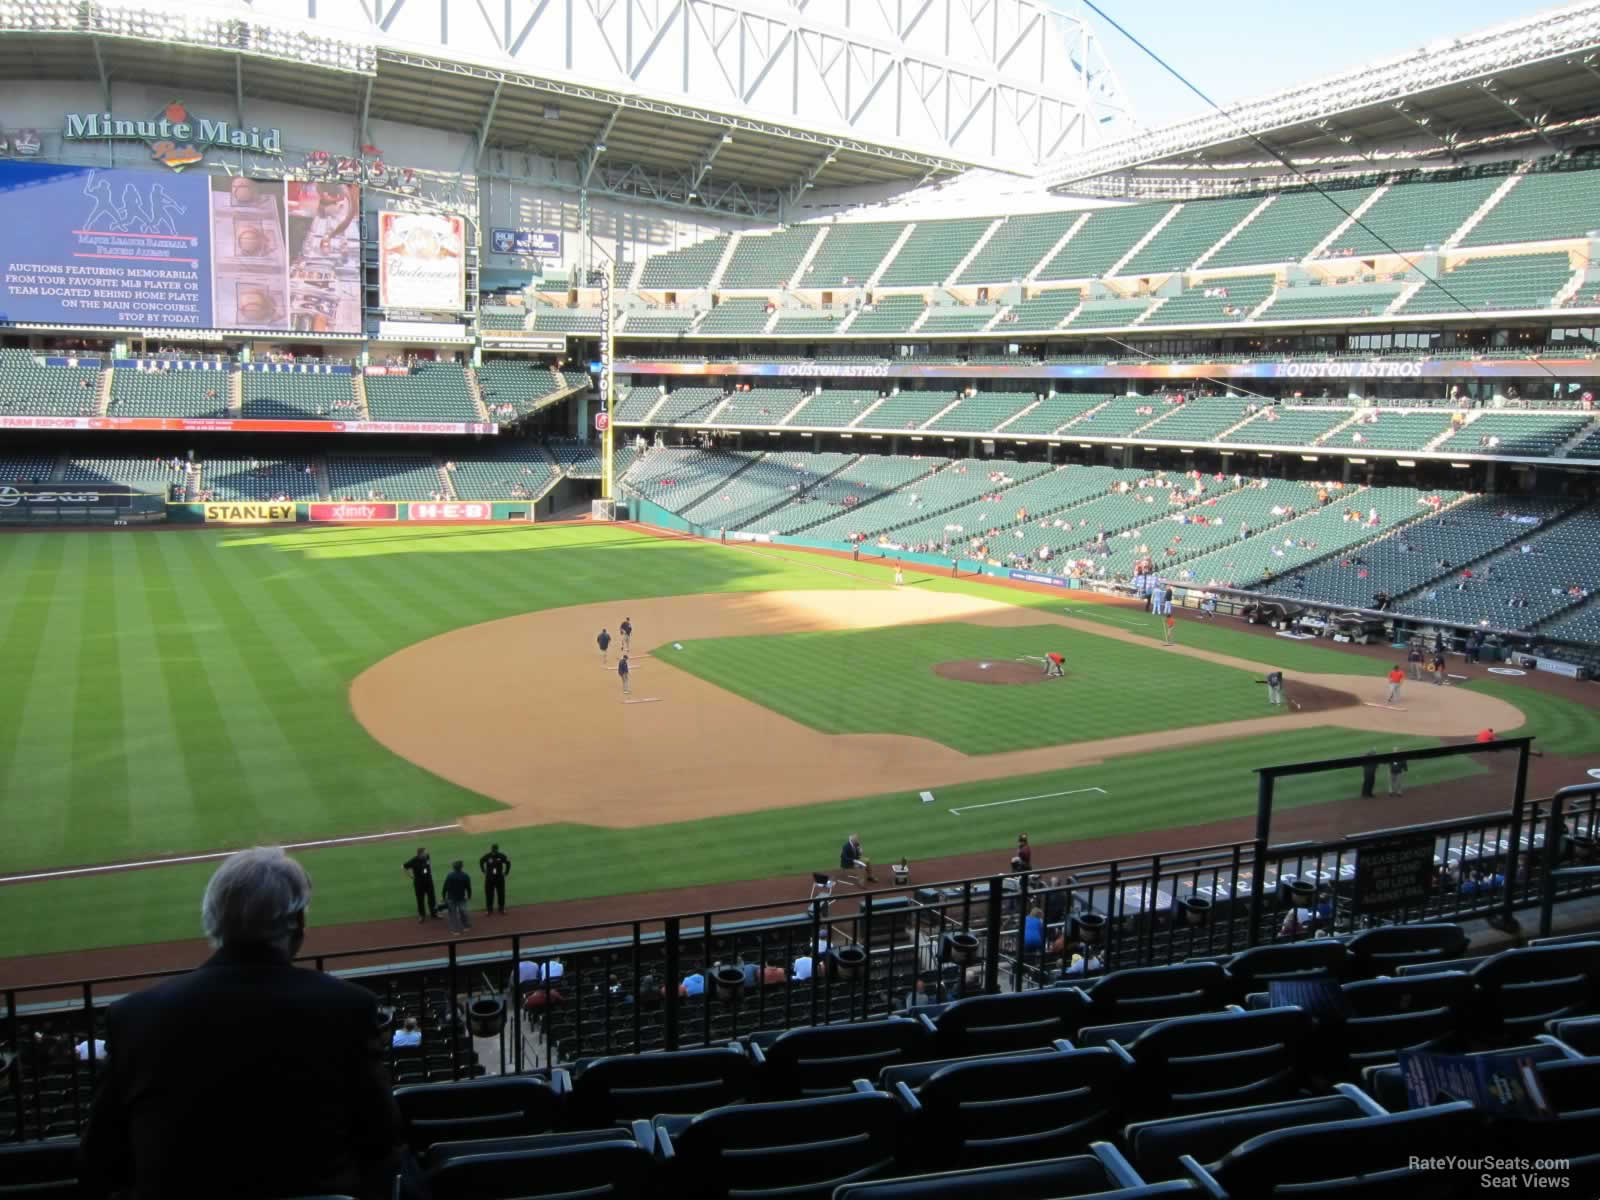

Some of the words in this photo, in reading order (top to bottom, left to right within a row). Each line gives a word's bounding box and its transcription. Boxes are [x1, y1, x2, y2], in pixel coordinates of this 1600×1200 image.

[66, 113, 192, 139] Minute
[199, 119, 282, 153] Maid
[8, 263, 63, 274] AUCTIONS
[65, 265, 125, 277] FEATURING
[127, 268, 198, 280] MEMORABILIA
[6, 275, 37, 284] FROM
[37, 276, 66, 285] YOUR
[69, 277, 118, 287] FAVORITE
[121, 279, 141, 288] MLB
[144, 281, 181, 290] PLAYER
[184, 283, 198, 291] OR
[8, 286, 39, 295] TEAM
[41, 287, 91, 297] LOCATED
[94, 290, 132, 299] BEHIND
[135, 291, 166, 300] HOME
[168, 293, 199, 302] PLATE
[62, 300, 77, 308] ON
[80, 300, 100, 309] THE
[103, 302, 130, 310] MAIN
[133, 303, 200, 313] CONCOURSE.
[118, 313, 145, 321] STOP
[147, 314, 160, 322] BY
[162, 314, 200, 323] TODAY!
[779, 365, 841, 377] HOUSTON
[841, 365, 889, 377] ASTROS
[1276, 362, 1352, 377] HOUSTON
[1357, 362, 1423, 377] ASTROS
[23, 491, 99, 502] LEXUS
[207, 505, 292, 519] STANLEY
[332, 504, 376, 520] xfinity
[418, 505, 483, 518] H-E-B
